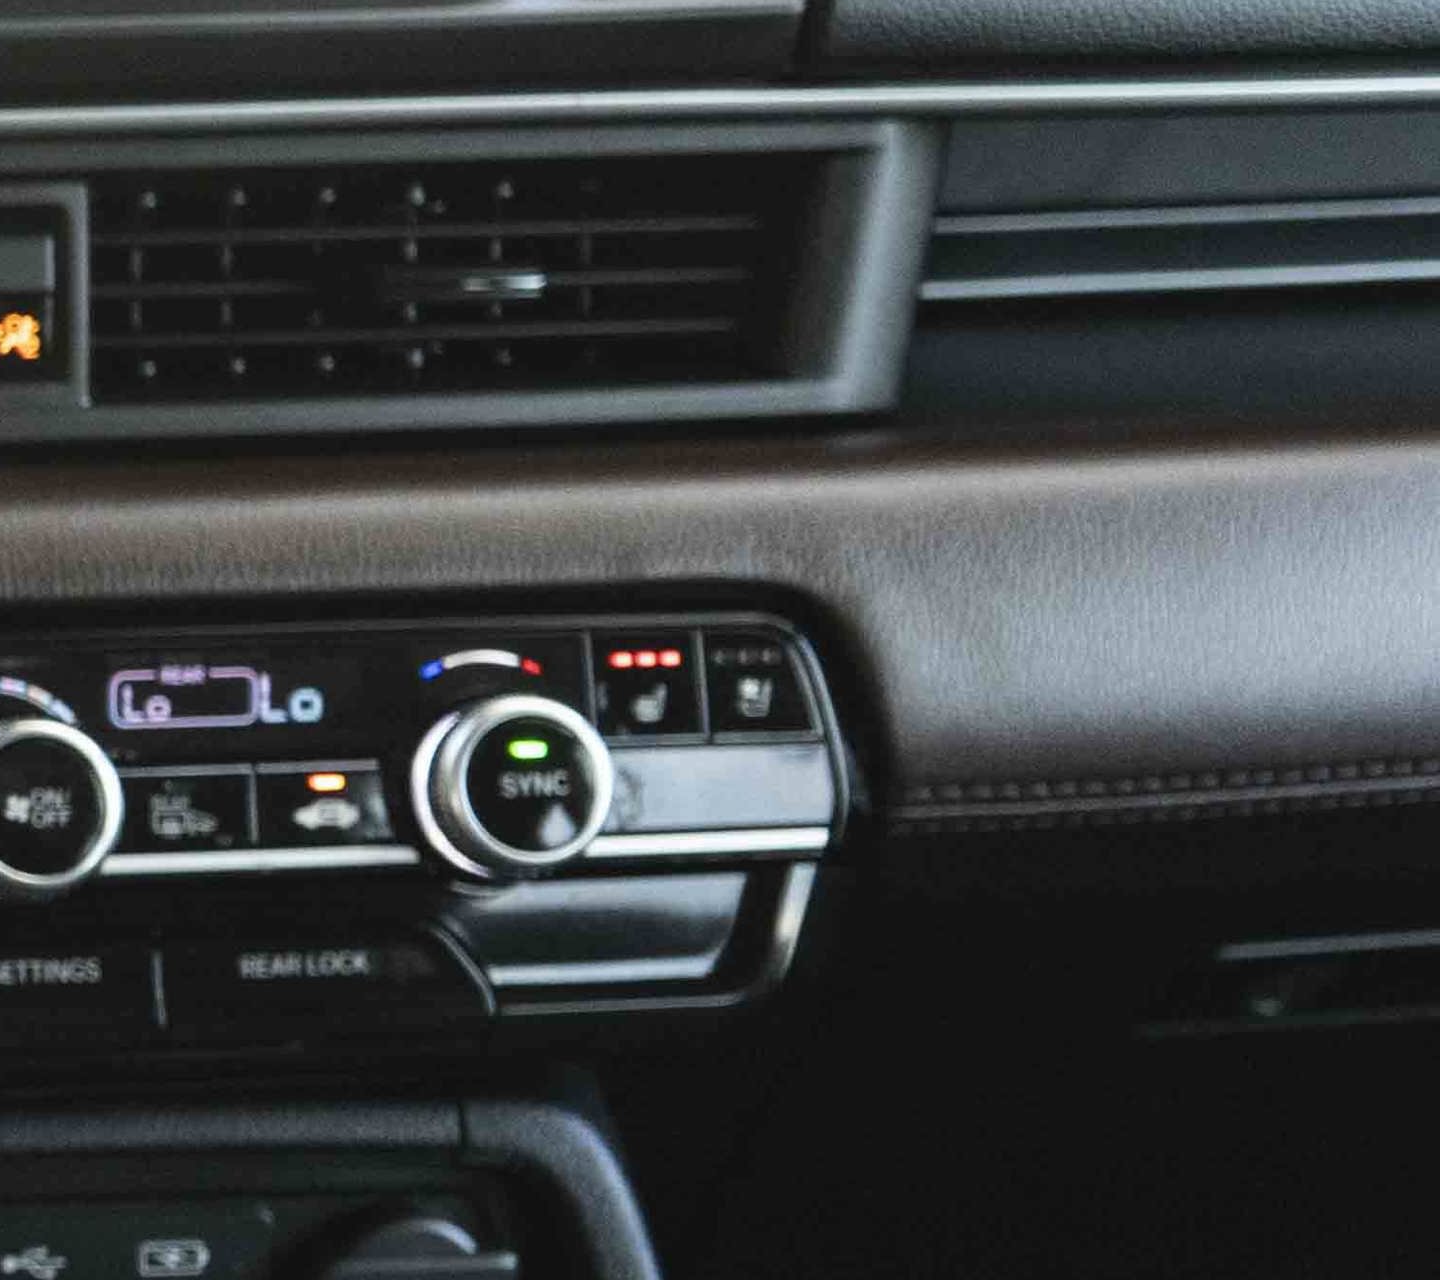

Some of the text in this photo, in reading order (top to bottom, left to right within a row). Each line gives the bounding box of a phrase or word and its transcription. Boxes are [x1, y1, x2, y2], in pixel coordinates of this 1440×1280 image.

[498, 770, 571, 800] SYNC
[238, 949, 369, 980] REAR LOCK
